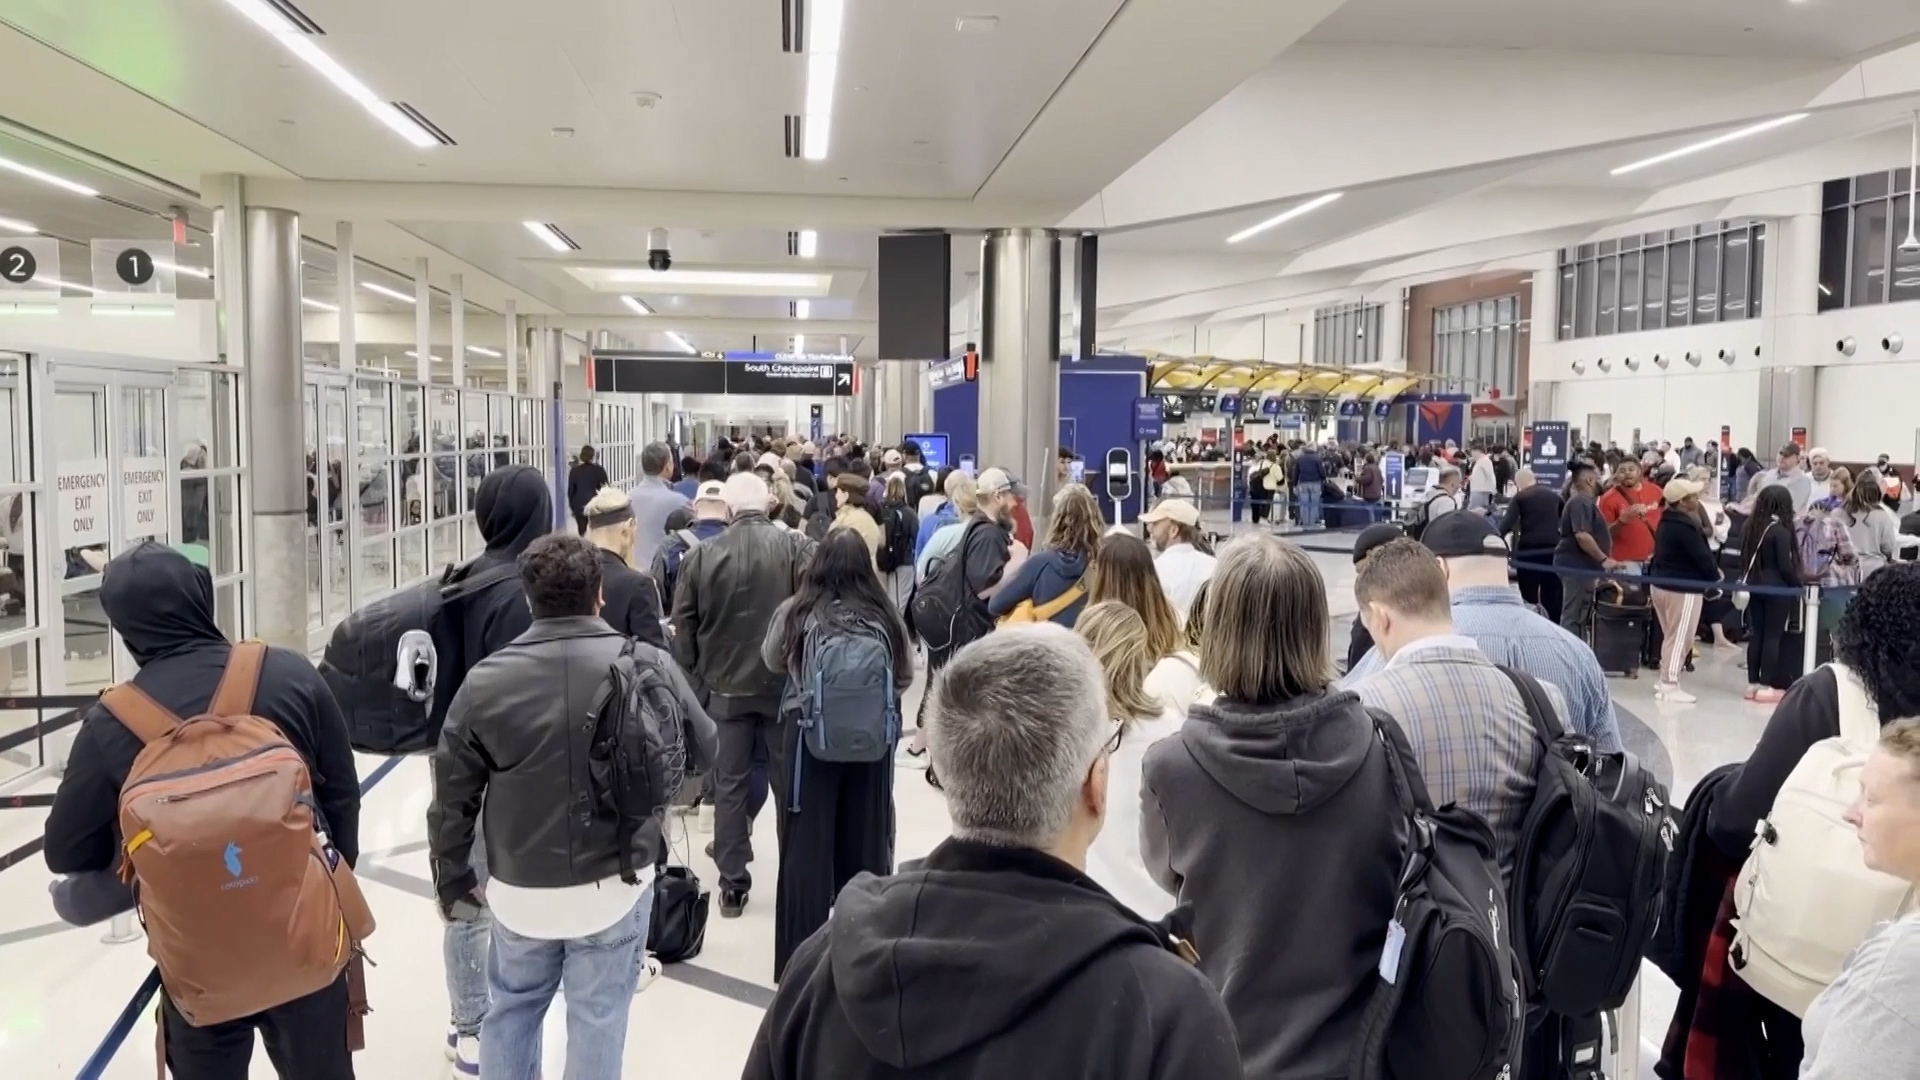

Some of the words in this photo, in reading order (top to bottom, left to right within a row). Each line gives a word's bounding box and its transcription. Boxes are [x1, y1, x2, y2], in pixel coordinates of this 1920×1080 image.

[9, 252, 26, 277] 2
[128, 255, 139, 278] 1
[744, 363, 770, 373] South
[57, 472, 107, 491] EMERGENCY
[123, 470, 164, 485] EMERGENCY
[75, 495, 92, 511] EXIT
[138, 490, 153, 504] EXIT
[136, 509, 155, 524] ONLY
[73, 517, 94, 532] ONLY
